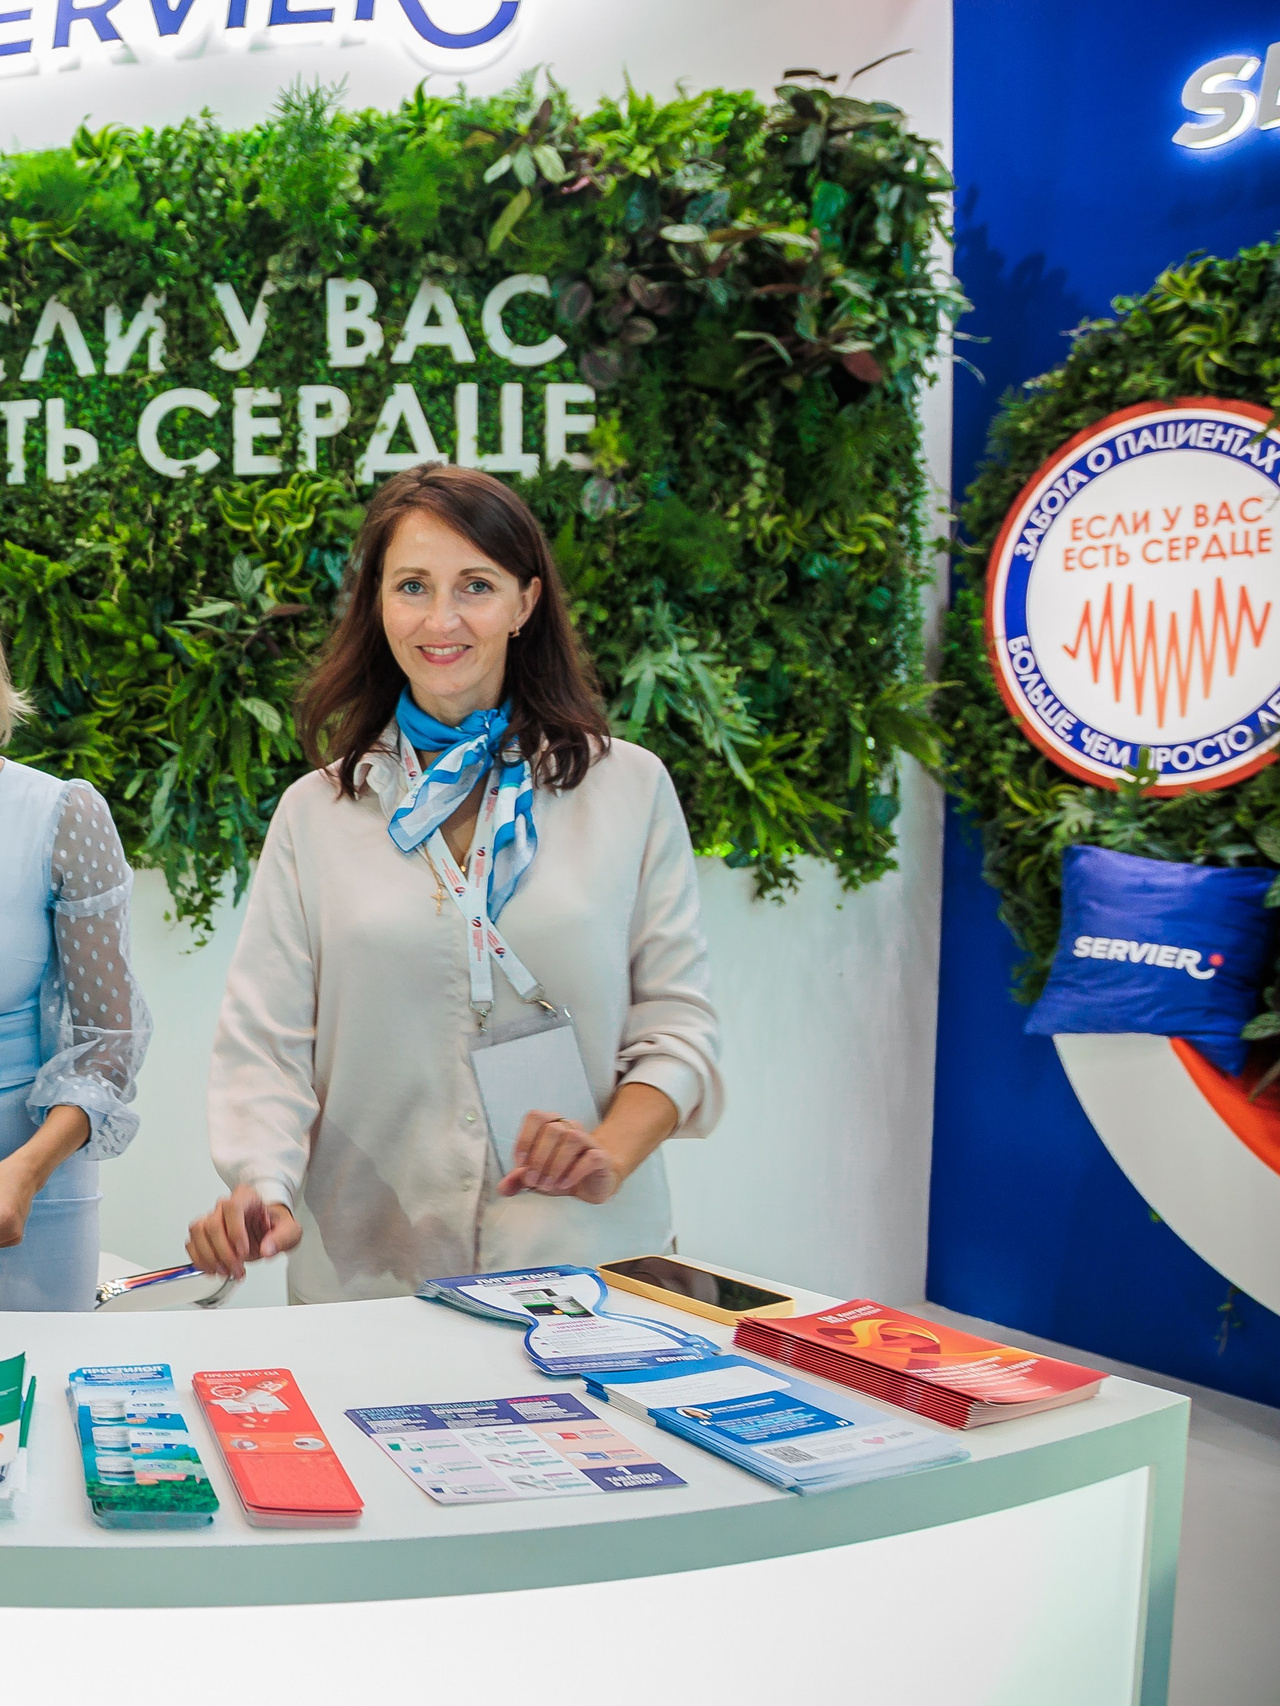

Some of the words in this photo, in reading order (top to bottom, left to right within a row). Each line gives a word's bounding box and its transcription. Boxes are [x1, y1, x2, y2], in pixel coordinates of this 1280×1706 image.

[1171, 40, 1280, 150] S
[210, 282, 271, 371] У
[327, 274, 568, 368] ВАС
[137, 383, 596, 484] СЕРДЦЕ
[1015, 471, 1088, 562] ЗАБОТА
[1086, 446, 1113, 474] О
[1114, 421, 1280, 474] ПАЦИЕНТАХ
[1071, 511, 1151, 541] ЕСЛИ
[1163, 507, 1183, 532] У
[1194, 496, 1265, 529] ВАС
[1063, 541, 1131, 572] ЕСТЬ
[1141, 528, 1274, 565] СЕРДЦЕ
[1006, 634, 1078, 743] БОЛЬШЕ,
[1080, 727, 1132, 767] ЧЕМ
[1072, 935, 1216, 980] SERVIER
